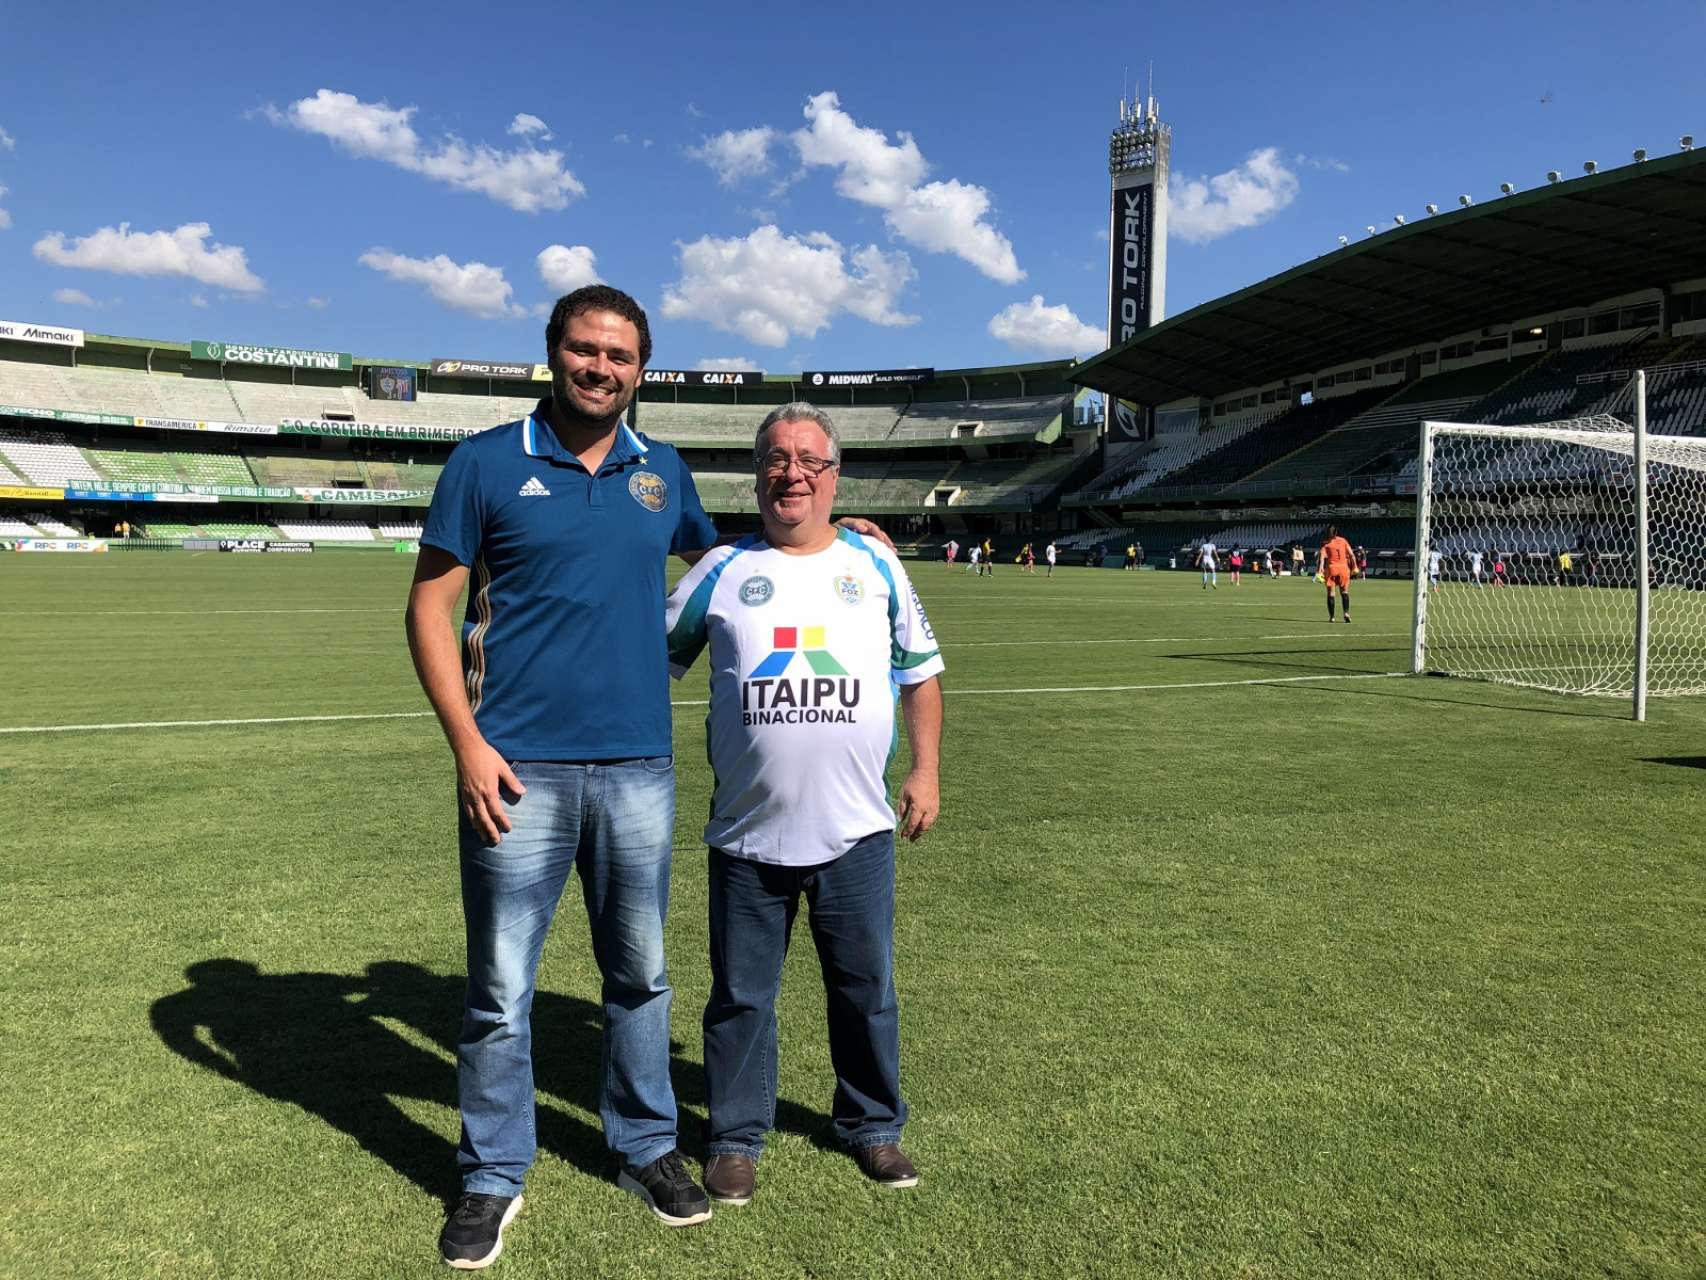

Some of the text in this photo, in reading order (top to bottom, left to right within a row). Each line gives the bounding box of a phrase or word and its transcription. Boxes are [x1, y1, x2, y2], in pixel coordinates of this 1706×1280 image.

[1123, 192, 1141, 290] TORK
[23, 328, 74, 341] Mimaki
[225, 344, 269, 353] HOSPITAL
[224, 350, 339, 368] COSTANTINI
[461, 364, 528, 374] PRO TORK
[644, 372, 686, 383] CAIXA
[703, 373, 744, 384] CAIXA
[223, 424, 273, 433] Rimatur
[295, 420, 474, 441] O CORITIBA EM PRIMEIRO
[519, 488, 551, 496] adidas
[227, 540, 265, 549] PLACE
[743, 678, 860, 710] ITAIPU
[743, 709, 856, 726] BINACIONAL
